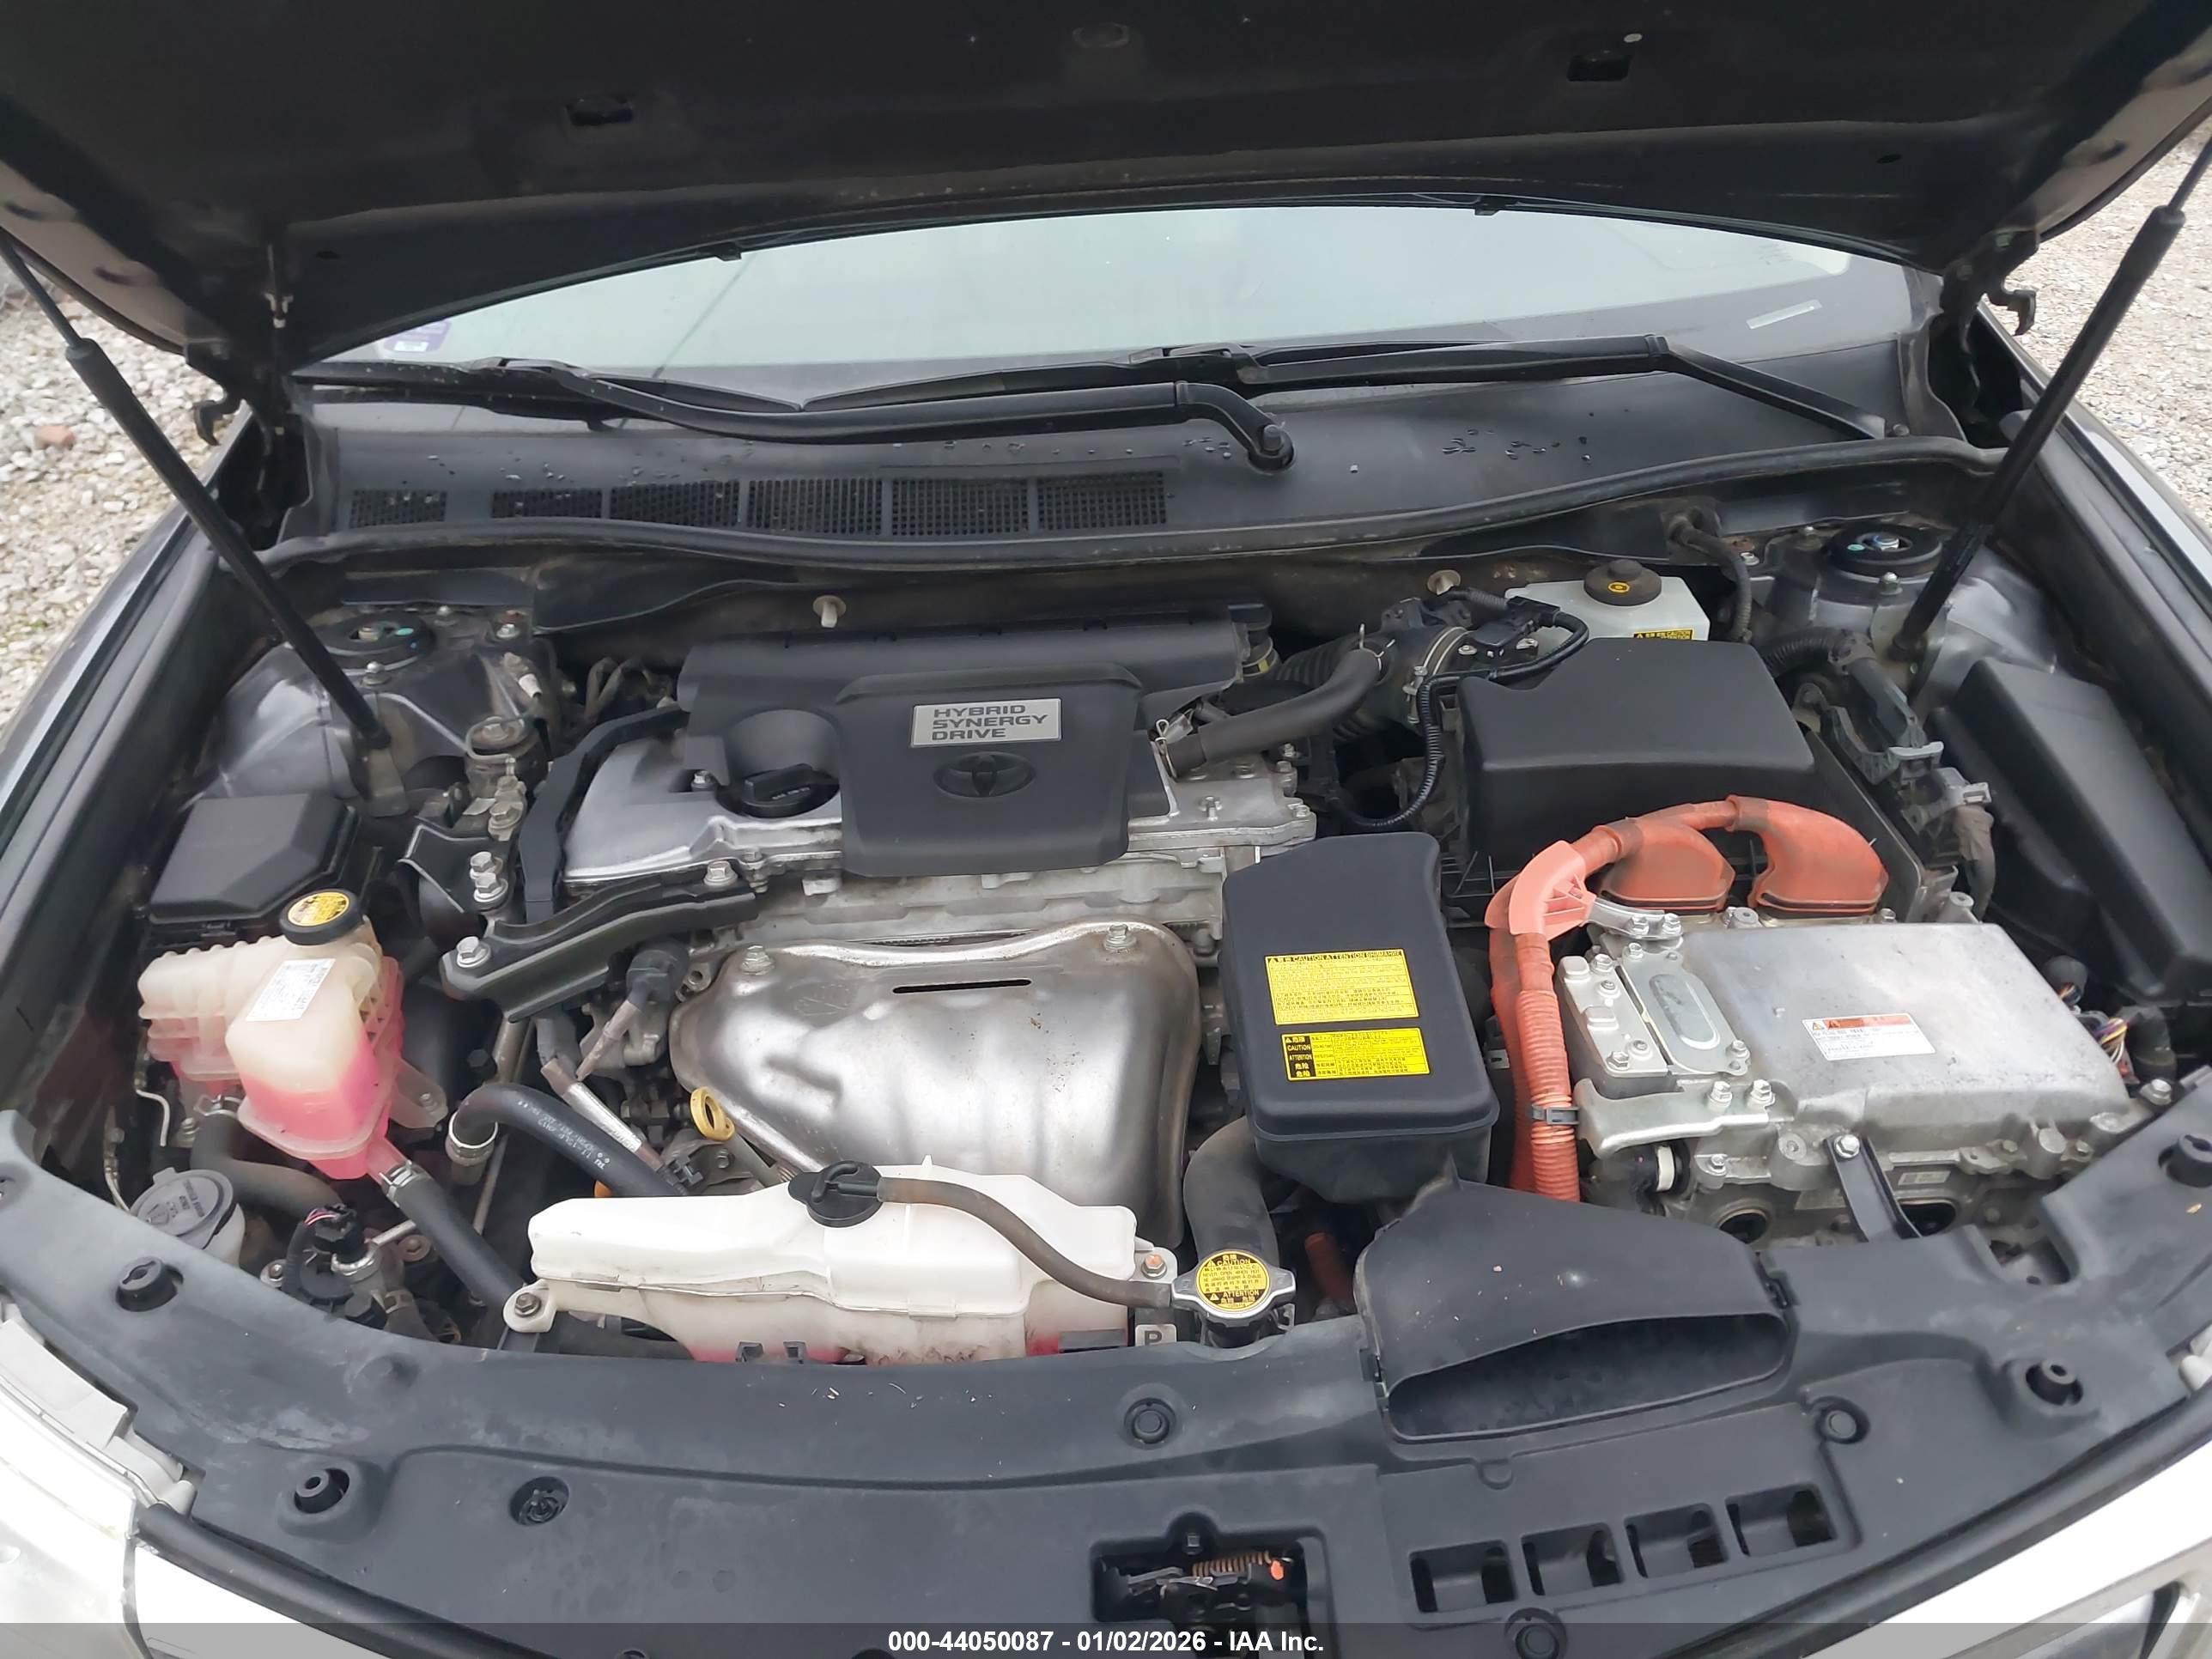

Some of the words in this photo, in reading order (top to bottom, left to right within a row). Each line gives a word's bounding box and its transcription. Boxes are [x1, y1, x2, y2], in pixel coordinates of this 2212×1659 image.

[933, 704, 1025, 718] HYBRID
[933, 714, 1048, 730] SYNERGY
[932, 728, 1006, 741] DRIVE
[1326, 952, 1365, 961] ATTENTION
[1289, 1053, 1313, 1061] ATTENTION
[1145, 1330, 1163, 1346] P
